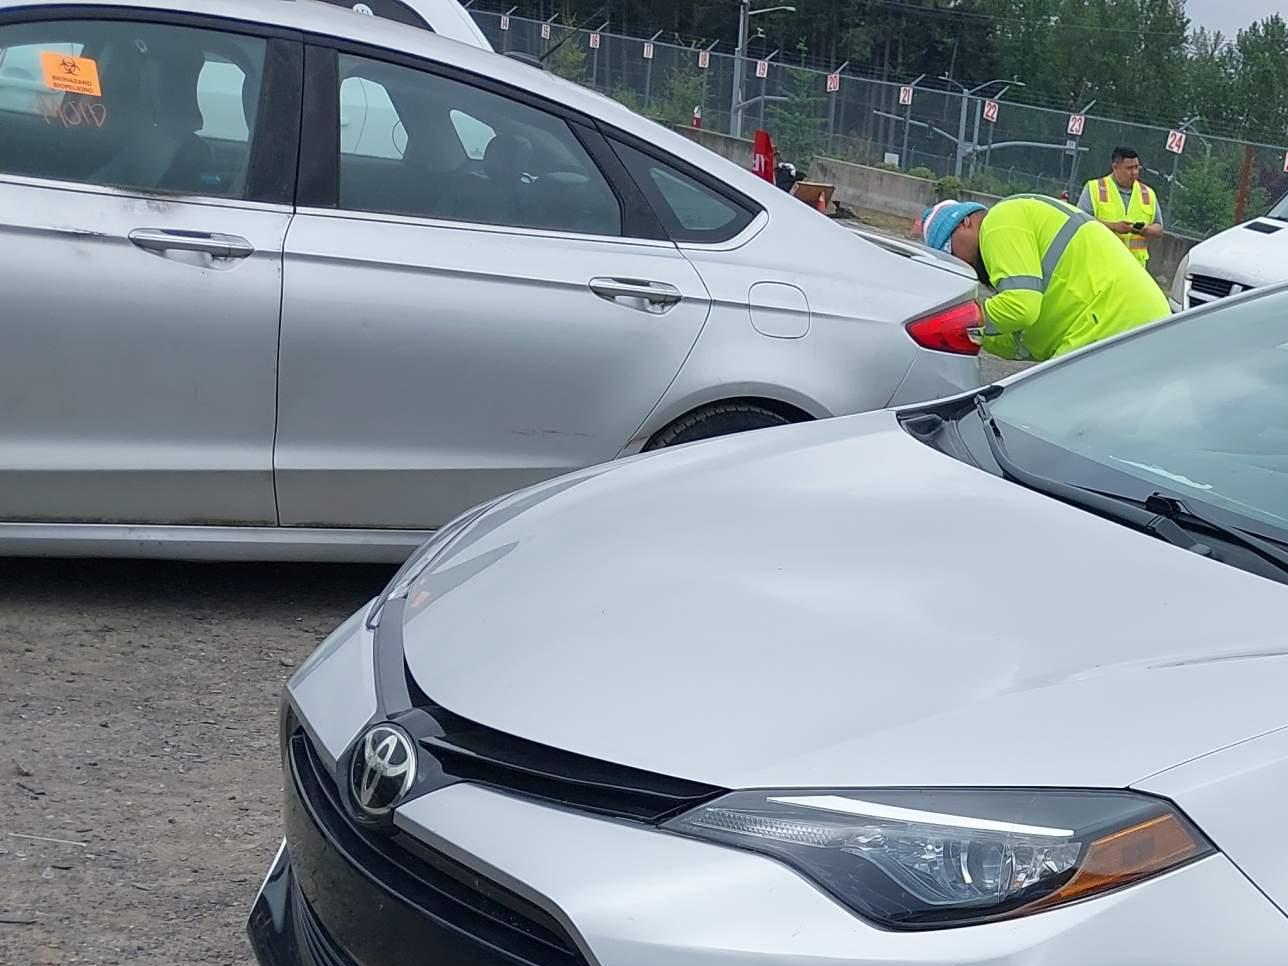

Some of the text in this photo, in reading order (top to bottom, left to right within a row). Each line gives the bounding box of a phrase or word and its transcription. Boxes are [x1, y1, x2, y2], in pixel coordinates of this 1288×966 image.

[757, 61, 767, 76] 19
[828, 75, 839, 90] 20
[901, 87, 911, 104] 21
[985, 102, 997, 120] 22
[1069, 116, 1083, 133] 23
[1167, 132, 1182, 151] 24
